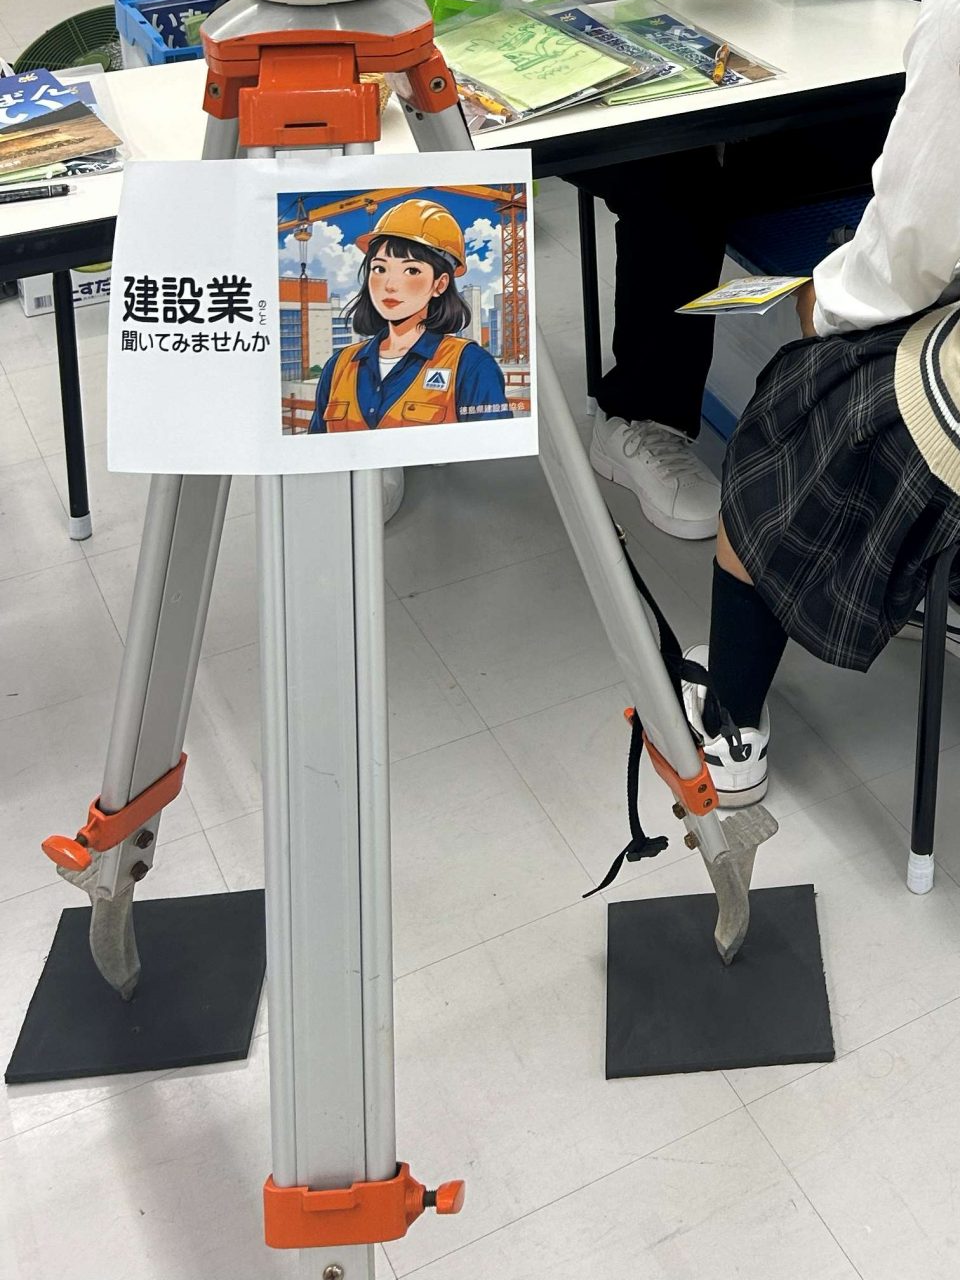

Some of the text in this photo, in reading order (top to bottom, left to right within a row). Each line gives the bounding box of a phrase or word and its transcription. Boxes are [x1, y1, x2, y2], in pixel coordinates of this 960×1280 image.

[122, 274, 254, 325] 建設業
[258, 300, 268, 326] のこと
[121, 329, 271, 354] 聞いてみませんか
